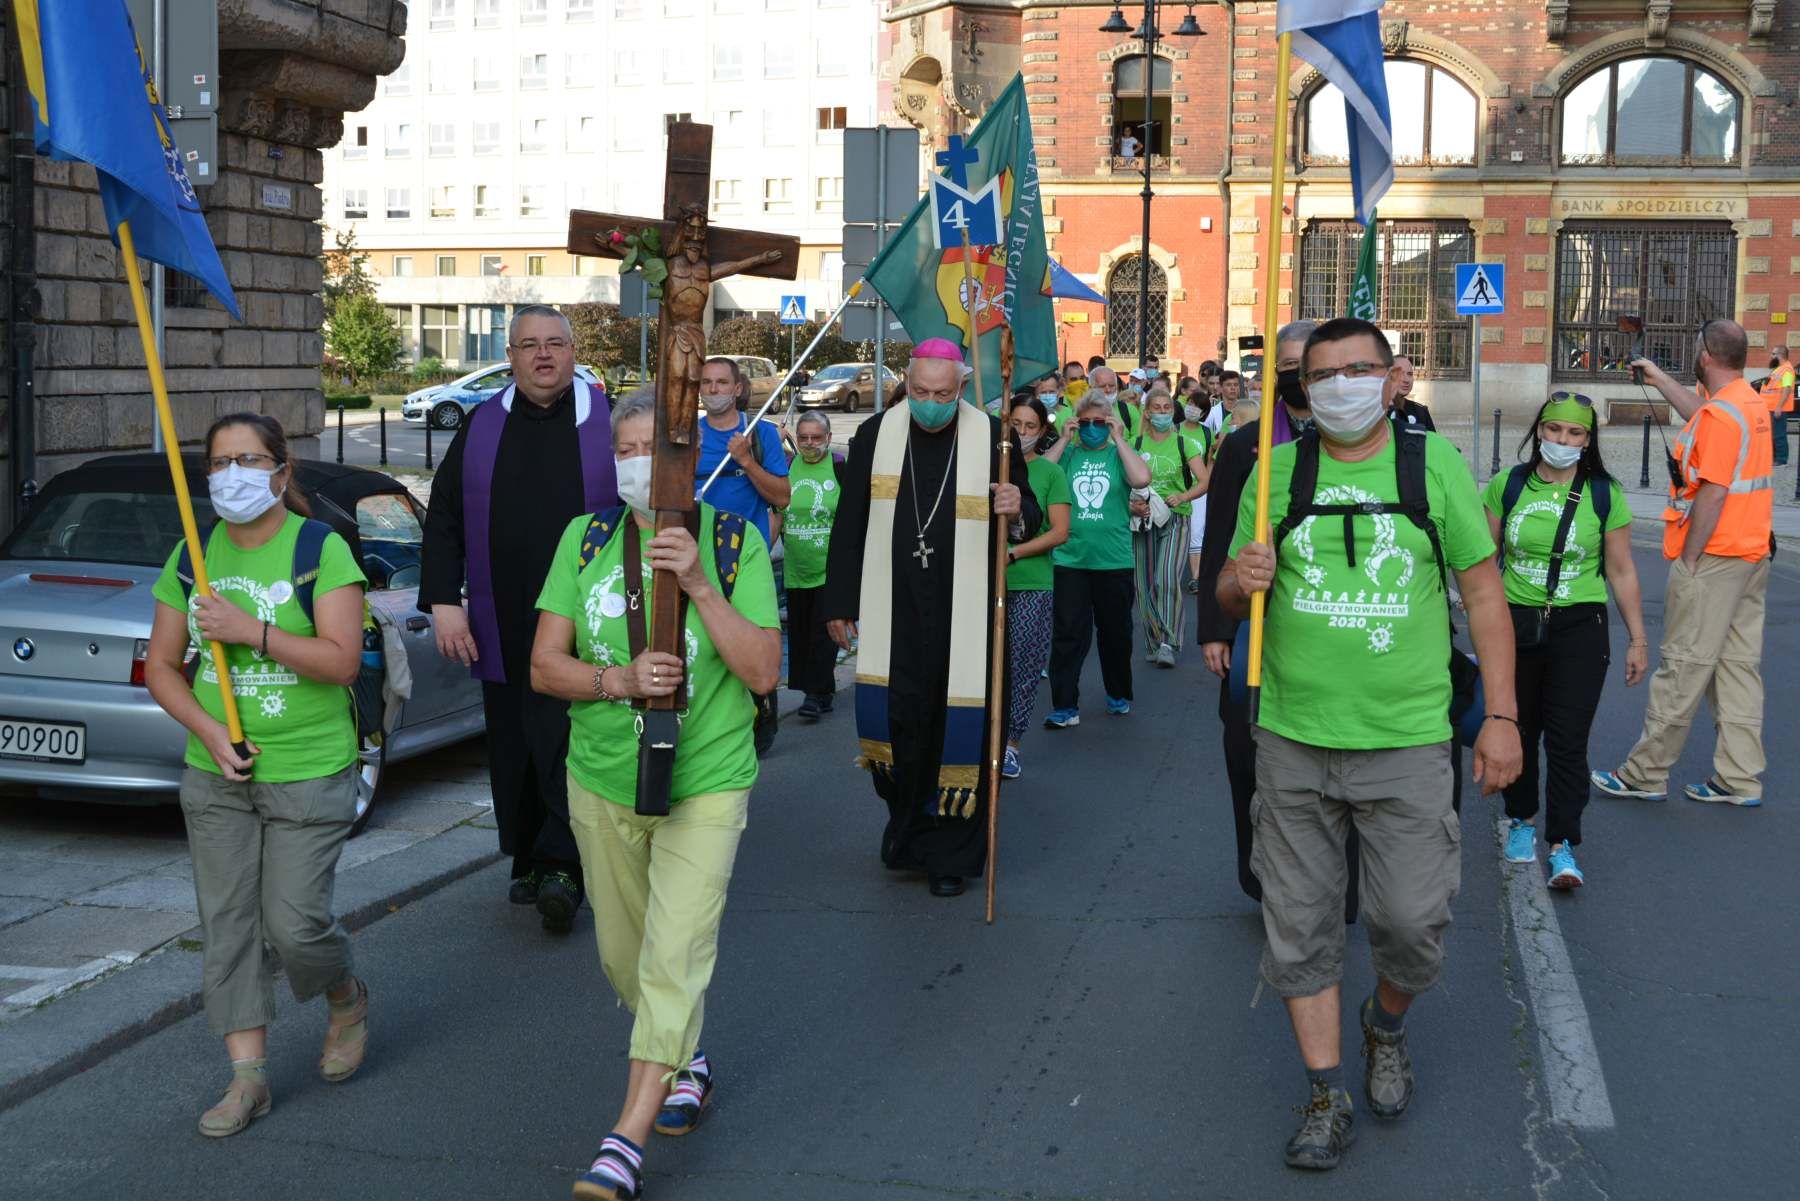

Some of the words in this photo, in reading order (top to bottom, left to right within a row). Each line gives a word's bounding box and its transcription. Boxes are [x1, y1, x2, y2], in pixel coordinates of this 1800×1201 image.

[1561, 200, 1604, 212] BANK
[942, 200, 971, 229] 4
[1295, 587, 1409, 604] ZARAŻENI
[1295, 600, 1407, 615] PIELGRZYMOWANIEM
[1328, 616, 1367, 628] 2020
[1, 724, 78, 755] 90900
